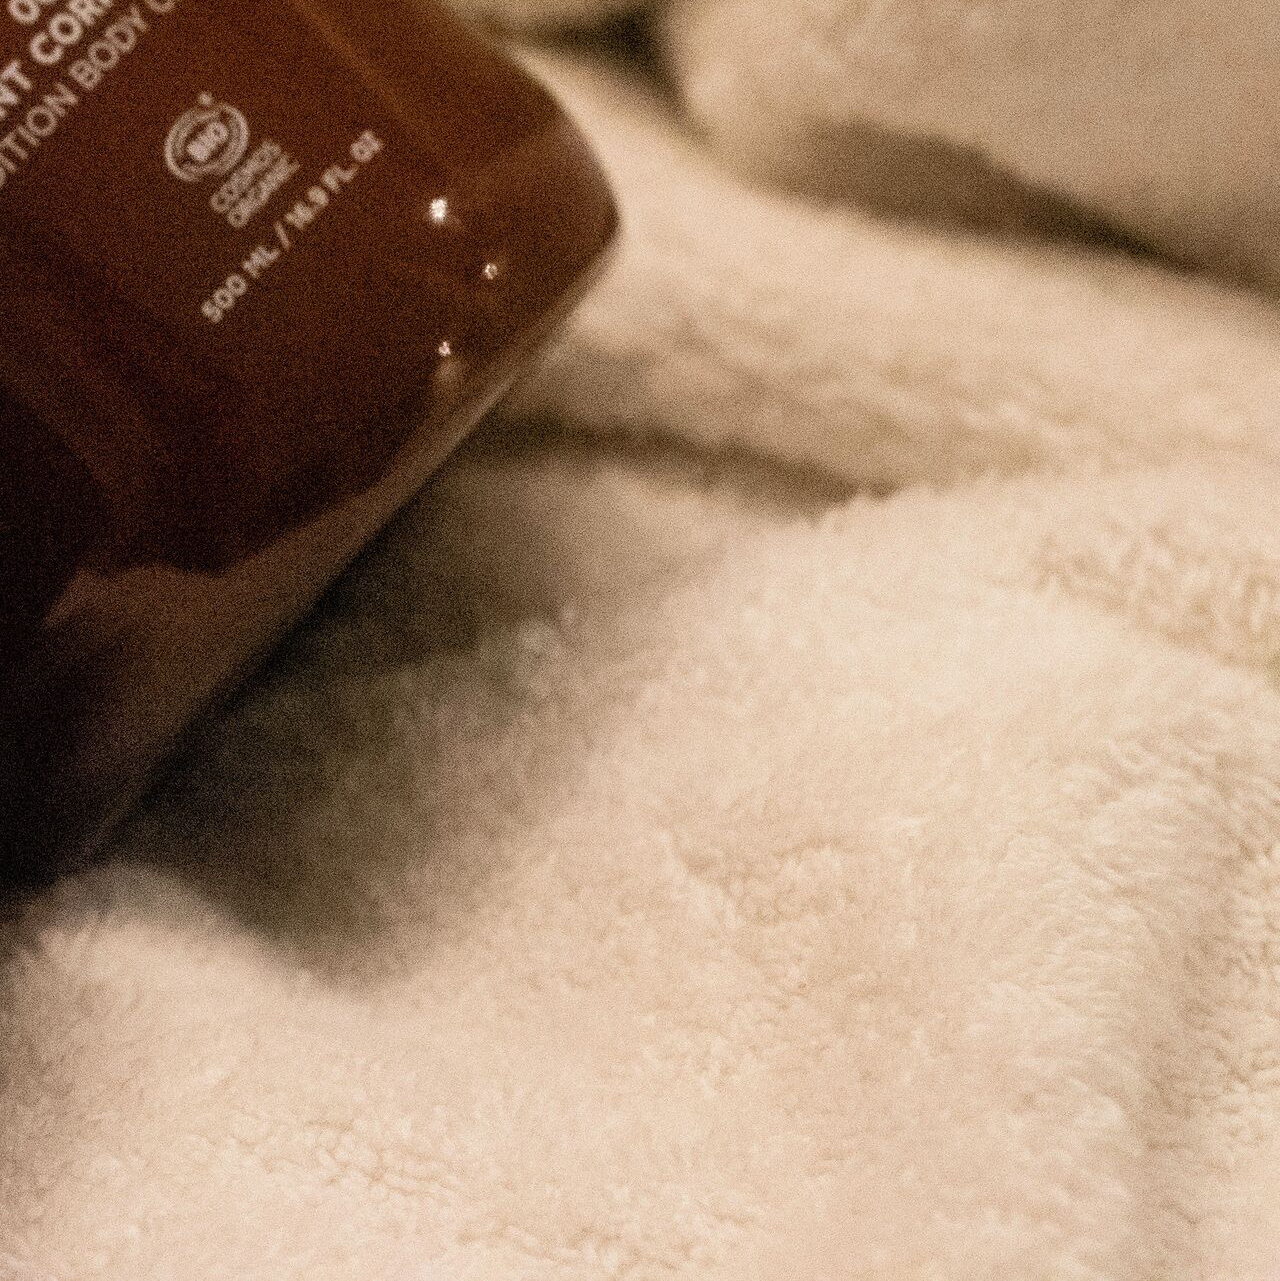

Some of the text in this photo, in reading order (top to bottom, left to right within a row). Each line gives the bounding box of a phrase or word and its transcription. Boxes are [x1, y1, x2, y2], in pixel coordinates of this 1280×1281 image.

[69, 6, 149, 89] BODY
[200, 273, 247, 322] 500
[243, 245, 281, 278] ML
